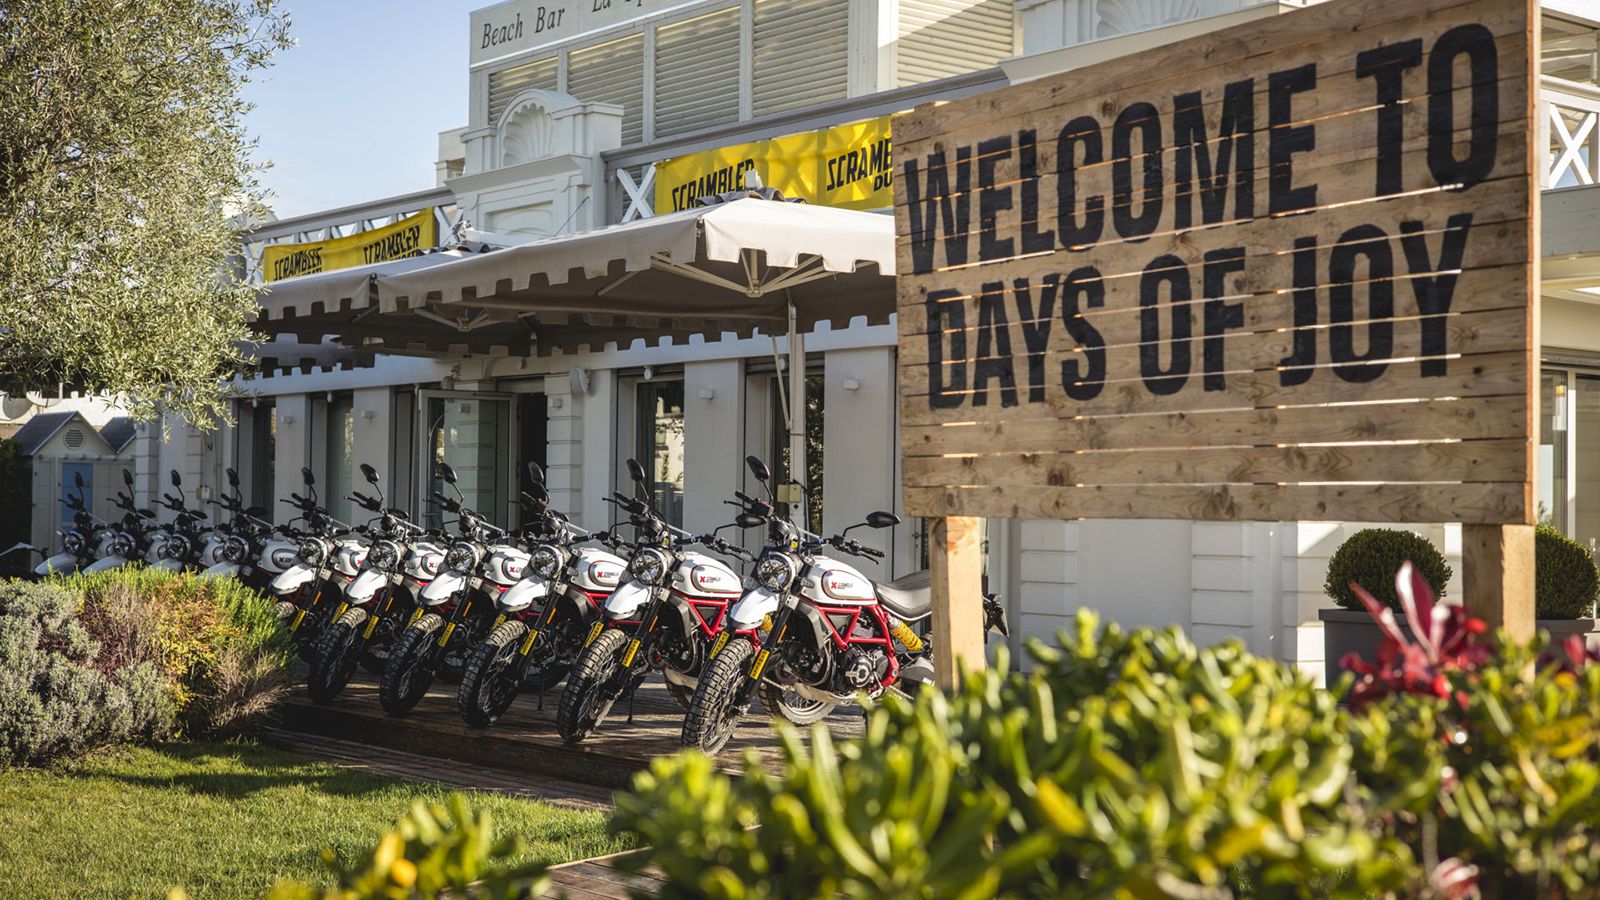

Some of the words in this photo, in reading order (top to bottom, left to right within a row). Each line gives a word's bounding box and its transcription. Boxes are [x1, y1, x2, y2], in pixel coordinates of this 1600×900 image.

[480, 13, 524, 49] Beach
[534, 6, 566, 34] Bar
[903, 62, 1318, 275] WELCOME
[1355, 22, 1501, 202] TO
[273, 246, 323, 281] SCRAMBLER
[363, 224, 420, 264] SCRAMBLER
[925, 265, 1108, 411] DAYS
[1138, 246, 1246, 396] OF
[1278, 212, 1474, 388] JOY
